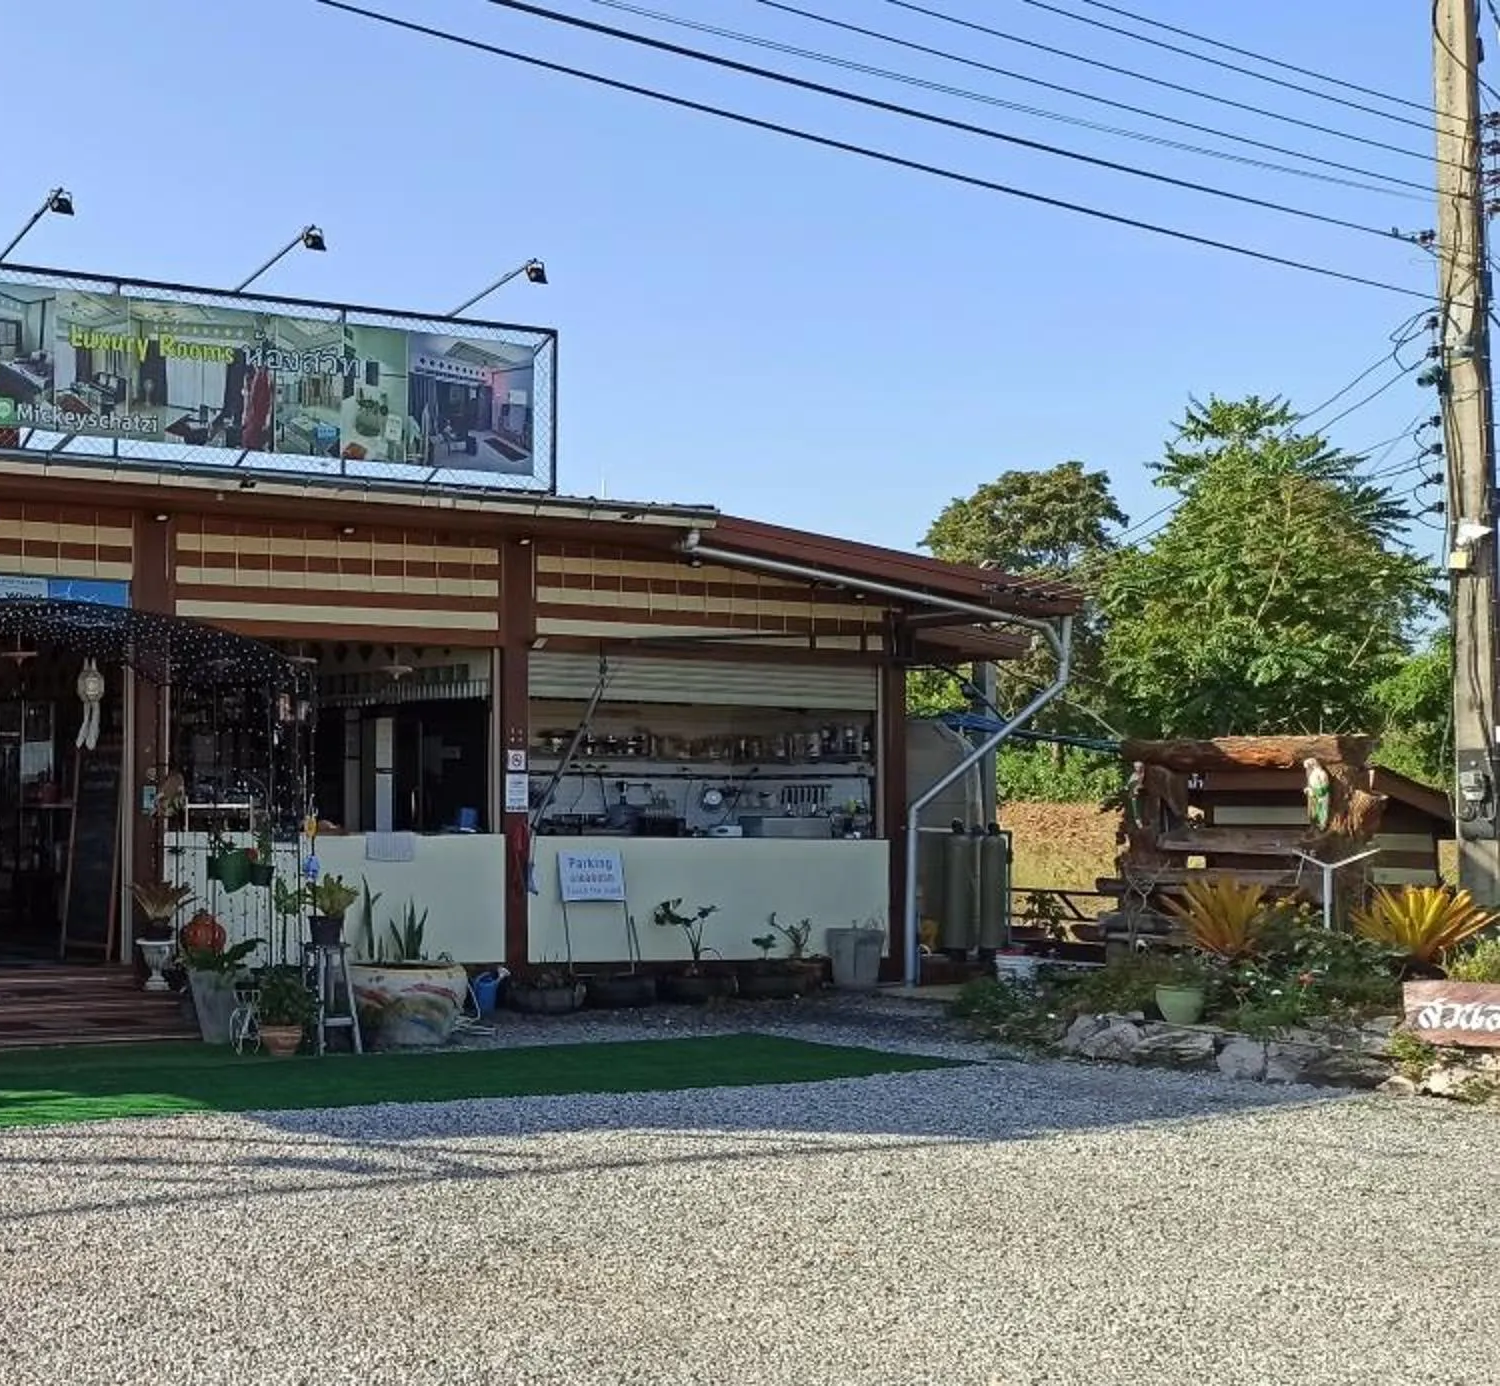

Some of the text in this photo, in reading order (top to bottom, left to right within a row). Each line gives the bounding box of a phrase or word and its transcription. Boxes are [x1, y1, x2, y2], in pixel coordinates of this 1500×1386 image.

[69, 324, 235, 364] Luxury Rooms
[568, 857, 613, 872] Parking
